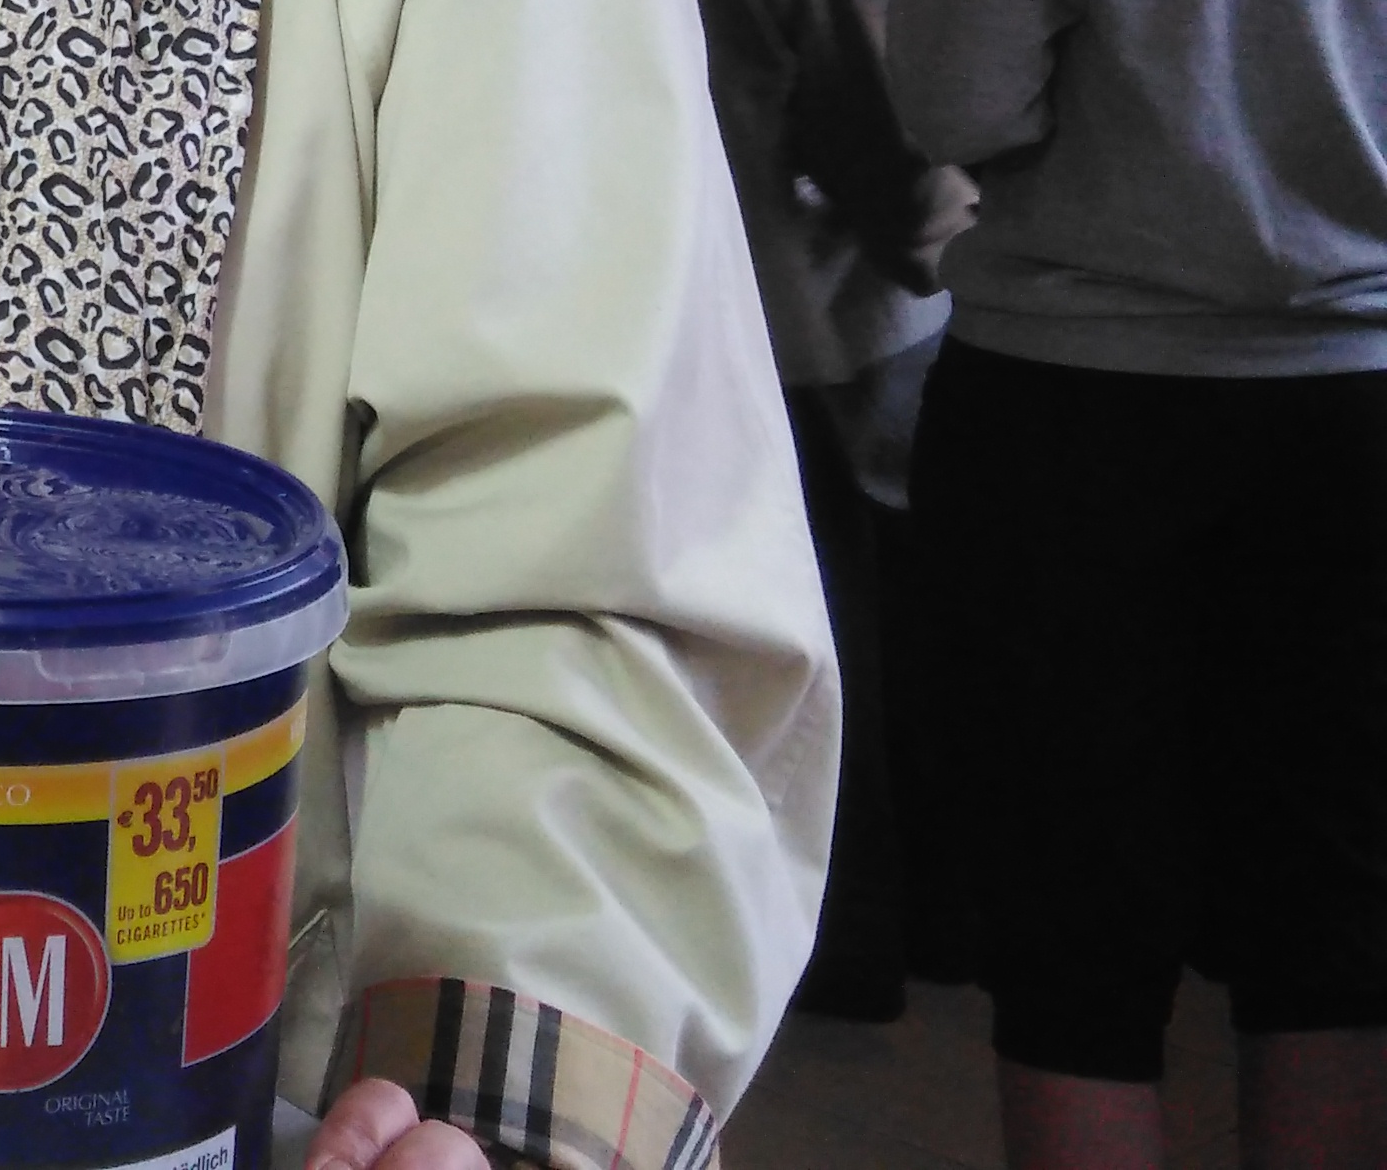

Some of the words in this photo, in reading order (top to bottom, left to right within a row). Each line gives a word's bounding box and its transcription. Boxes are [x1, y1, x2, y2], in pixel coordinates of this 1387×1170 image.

[117, 905, 136, 922] Up
[139, 902, 152, 918] to
[153, 861, 210, 916] 650
